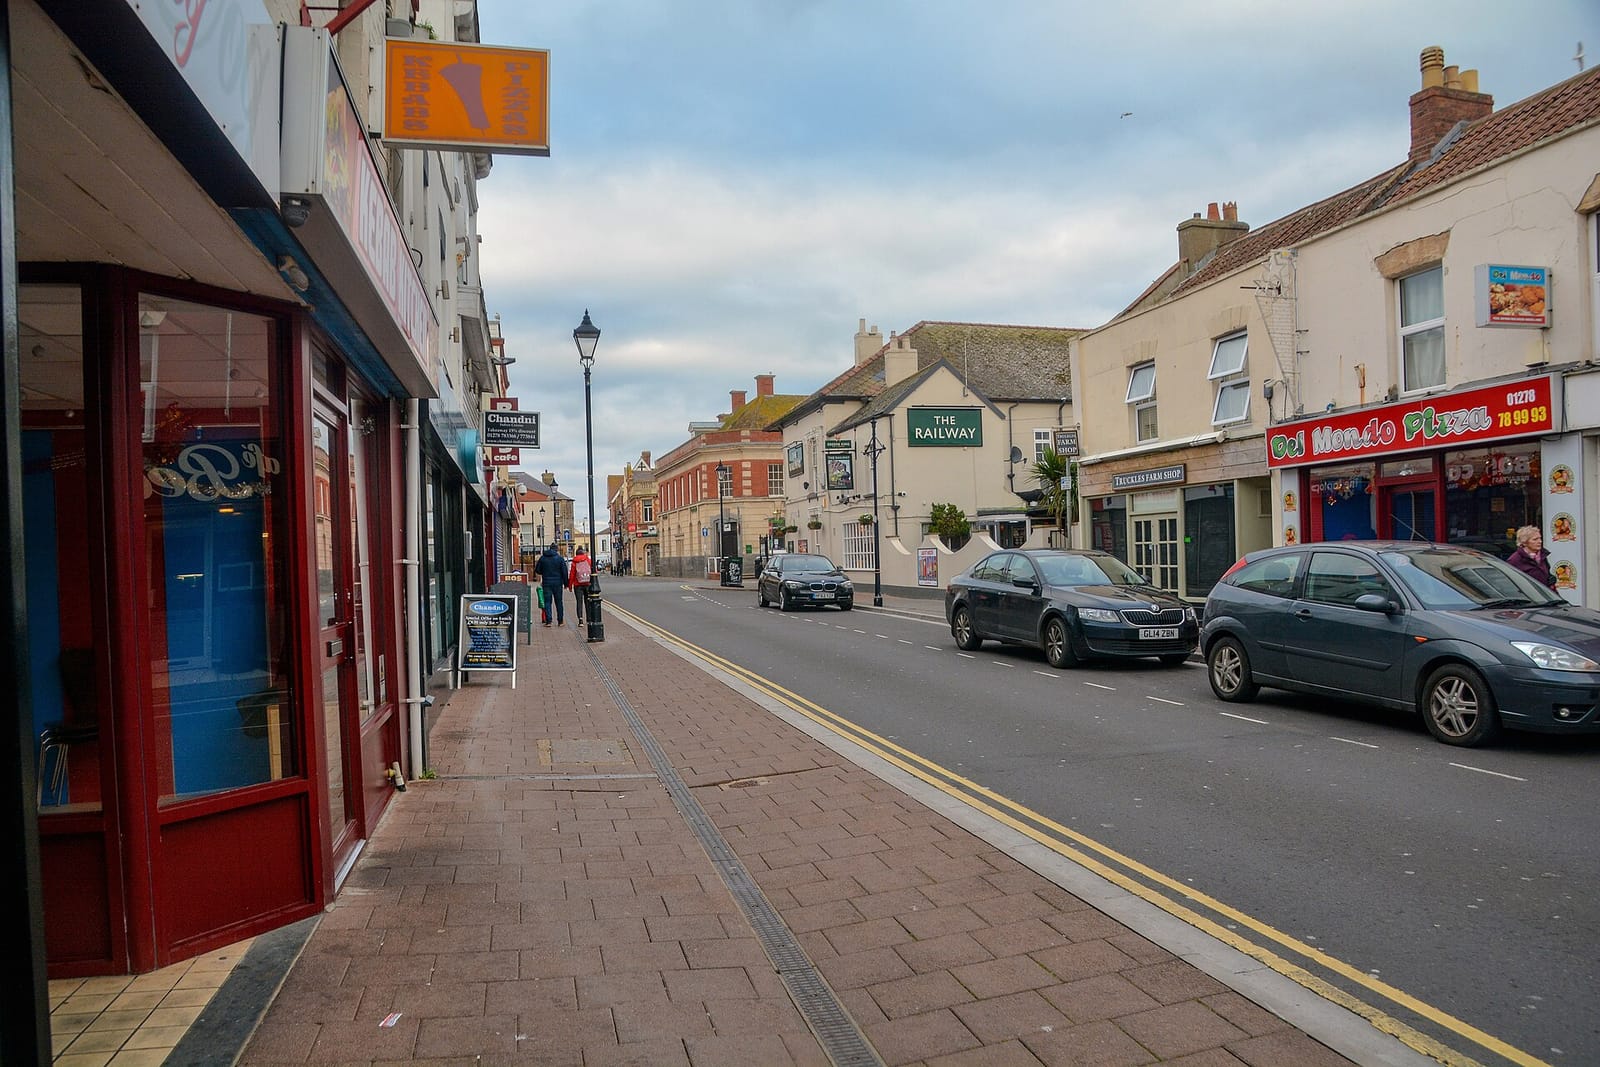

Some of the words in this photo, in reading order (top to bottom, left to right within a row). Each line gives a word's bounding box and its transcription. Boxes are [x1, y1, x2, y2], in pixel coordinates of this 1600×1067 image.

[402, 55, 432, 131] KEBABS
[502, 62, 530, 135] PIZZAS
[1506, 389, 1536, 406] 01278
[487, 413, 536, 424] Chandni
[933, 415, 956, 425] THE
[1498, 411, 1512, 427] 78
[1513, 408, 1529, 425] 99
[1530, 405, 1547, 423] 93
[915, 427, 976, 439] RAILWAY
[1271, 430, 1305, 460] Del
[1312, 417, 1396, 456] Mondo
[1402, 406, 1493, 442] Pizza
[1114, 474, 1145, 486] TRUCKLES
[1145, 472, 1163, 482] FARM
[1163, 469, 1181, 480] SHOP
[1143, 630, 1160, 638] GL14
